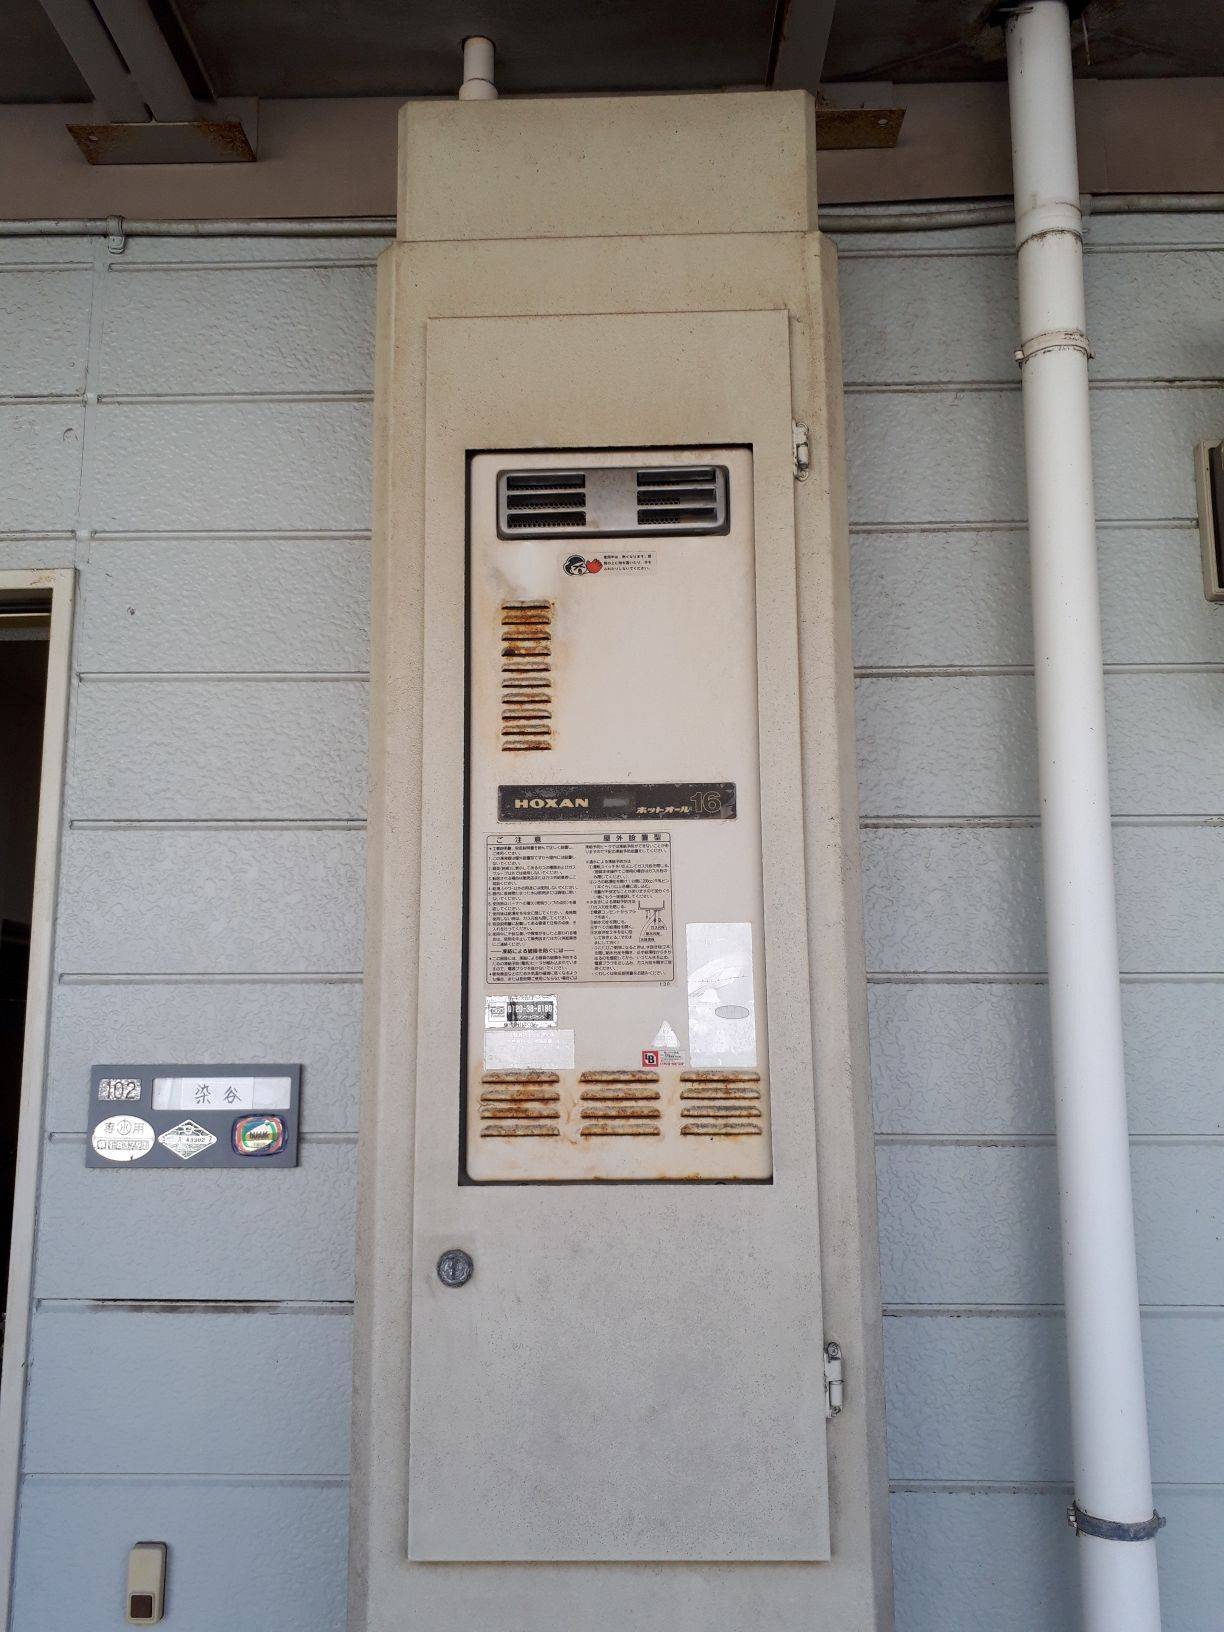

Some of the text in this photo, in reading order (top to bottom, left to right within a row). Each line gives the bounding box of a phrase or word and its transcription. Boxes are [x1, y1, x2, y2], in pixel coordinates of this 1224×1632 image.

[514, 798, 589, 809] HOXAN
[635, 791, 722, 814] ホットオール 16
[603, 833, 662, 842] 屋外設置型
[106, 1080, 136, 1099] 102
